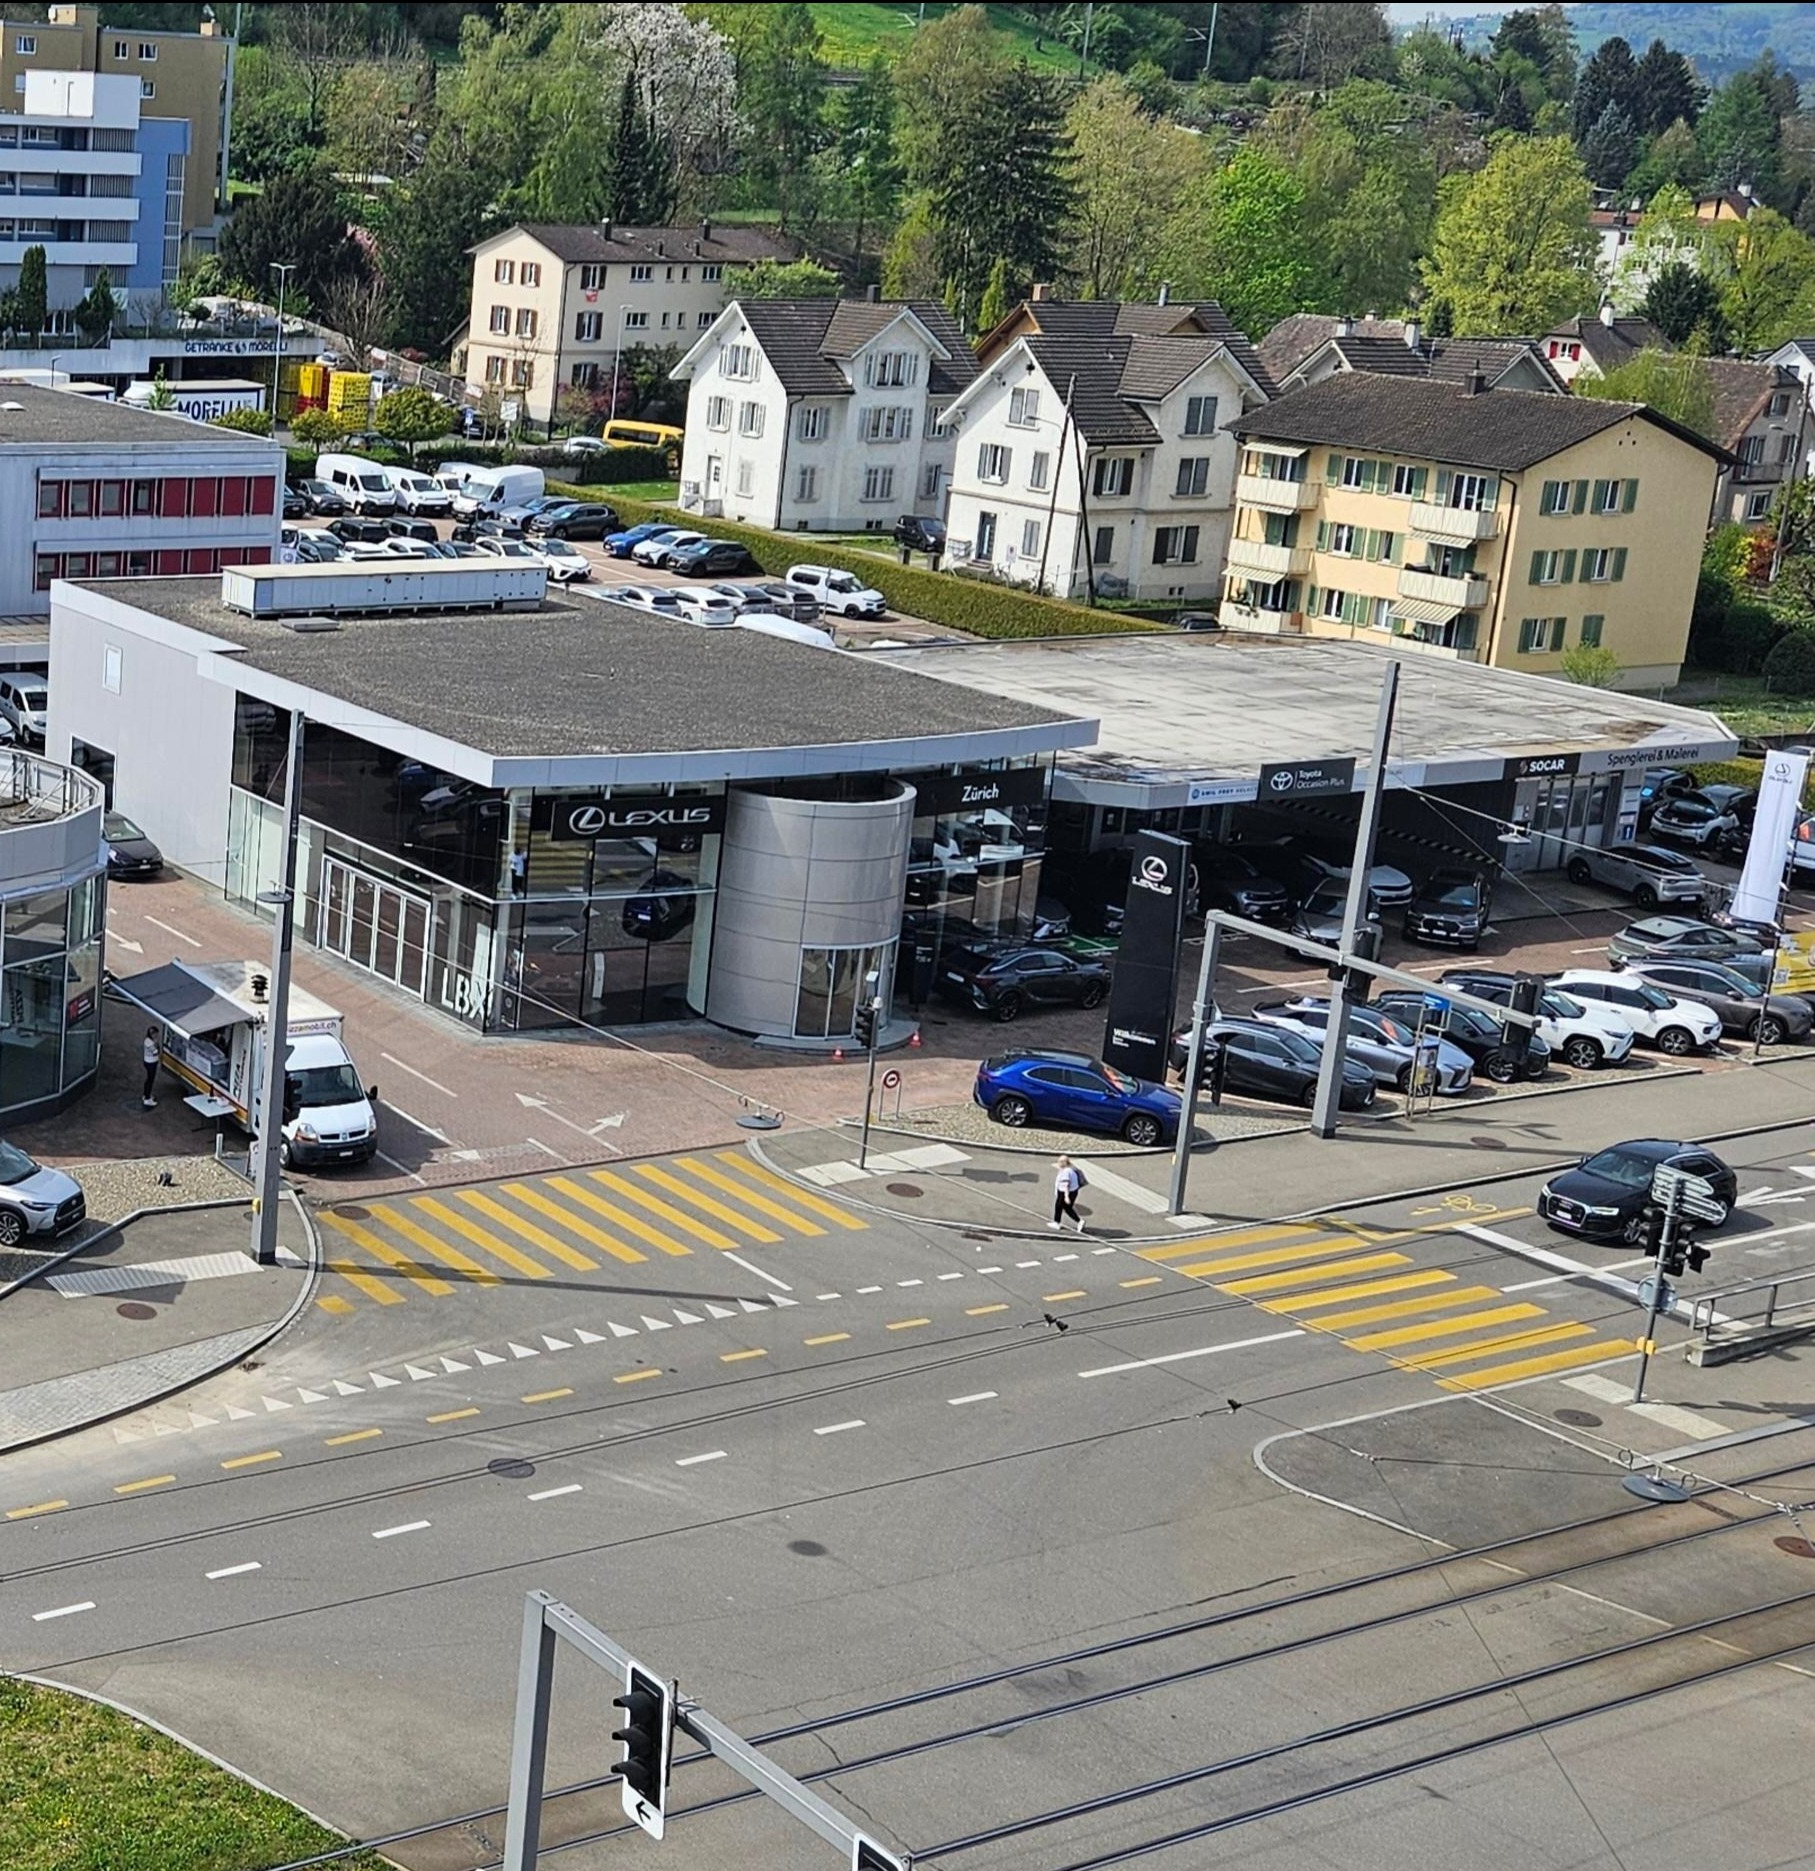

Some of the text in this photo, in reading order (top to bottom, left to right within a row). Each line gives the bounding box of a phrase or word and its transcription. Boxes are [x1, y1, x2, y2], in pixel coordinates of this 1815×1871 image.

[1607, 749, 1656, 767] Spenglerei
[1664, 747, 1699, 760] Malerei
[1529, 759, 1566, 772] SOCAR
[1299, 770, 1322, 780] Toyota
[1297, 779, 1329, 789] Occasion
[961, 783, 999, 802] Zürich
[608, 808, 711, 826] LEXUS
